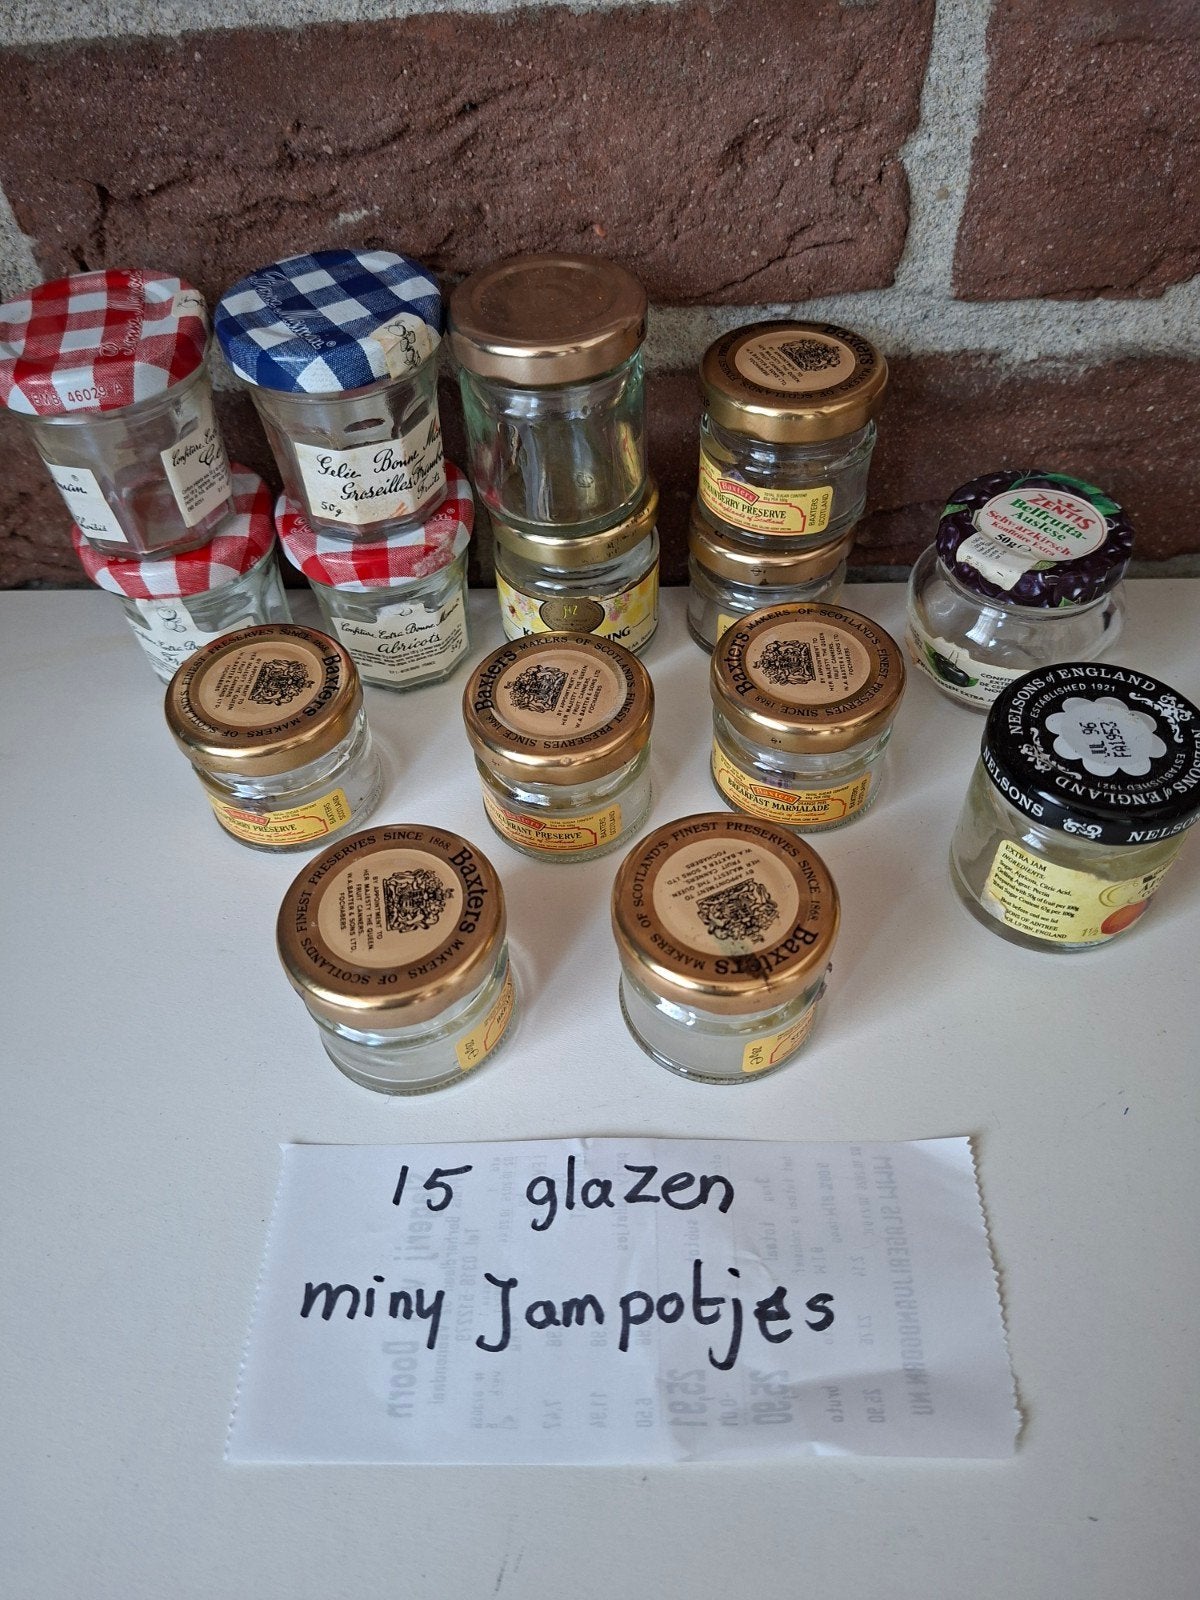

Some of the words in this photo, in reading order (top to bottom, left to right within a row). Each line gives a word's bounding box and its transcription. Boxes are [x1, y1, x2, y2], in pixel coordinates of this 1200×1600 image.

[68, 386, 107, 403] 46029
[114, 382, 123, 394] A
[340, 473, 413, 501] Groseilles
[742, 505, 786, 519] PRESERVE
[808, 498, 818, 526] BAXTERS
[818, 494, 829, 526] SCOTLAND
[1010, 498, 1087, 540] Belfrutta-
[1027, 494, 1095, 530] ZENTIS
[995, 534, 1017, 548] 50g
[1011, 512, 1066, 541] Auslese
[279, 628, 312, 641] SINCE
[748, 609, 791, 631] MAKERS
[819, 609, 880, 645] SCOTLAND'S
[209, 628, 274, 655] PRESERVES
[519, 636, 568, 651] MAKERS
[576, 637, 592, 645] OF
[182, 657, 205, 686] FINEST
[594, 642, 635, 688] SCOTLAND'S
[724, 632, 757, 696] Baxters
[877, 648, 890, 679] FINEST
[302, 653, 342, 717] Baxters
[474, 650, 518, 714] Baxters
[181, 690, 219, 734] SCOTLAND'S
[614, 693, 635, 724] FINEST
[780, 706, 818, 717] SINCE
[826, 683, 883, 716] PRESERVES
[1008, 677, 1045, 735] NELSONS
[1045, 673, 1055, 684] of
[1056, 667, 1156, 691] ENGLAND
[1030, 683, 1087, 719] ESTABLISHED
[1091, 683, 1116, 693] 1921
[221, 730, 239, 738] OF
[248, 718, 301, 738] MAKERS
[502, 729, 537, 747] SINCE
[544, 725, 614, 749] PRESERVES
[983, 746, 1044, 817] NELSONS
[1097, 782, 1123, 791] 1921
[1127, 753, 1186, 792] ESTABLISHED
[728, 778, 769, 807] BREAKFAST
[772, 803, 830, 812] MARMALADE
[1056, 775, 1163, 805] ENGLAND
[1164, 787, 1173, 800] of
[253, 823, 297, 833] PRESERVE
[383, 831, 424, 841] SINCE
[535, 831, 581, 840] PRESERVE
[671, 822, 719, 842] FINEST
[727, 822, 800, 858] PRESERVES
[309, 835, 377, 885] PRESERVES
[633, 840, 669, 908] SCOTLAND'S
[1006, 845, 1029, 864] EXTRA
[1031, 861, 1047, 872] JAM
[449, 847, 488, 934] Baxters
[799, 860, 821, 894] SINCE
[296, 890, 311, 933] FINEST
[637, 913, 651, 928] OF
[301, 937, 372, 984] SCOTLAND'S
[409, 938, 464, 979] MAKERS
[651, 933, 706, 969] MAKERS
[377, 974, 398, 984] OF
[393, 1165, 473, 1211] 15
[526, 1154, 734, 1232] glazen
[300, 1274, 445, 1350] miny
